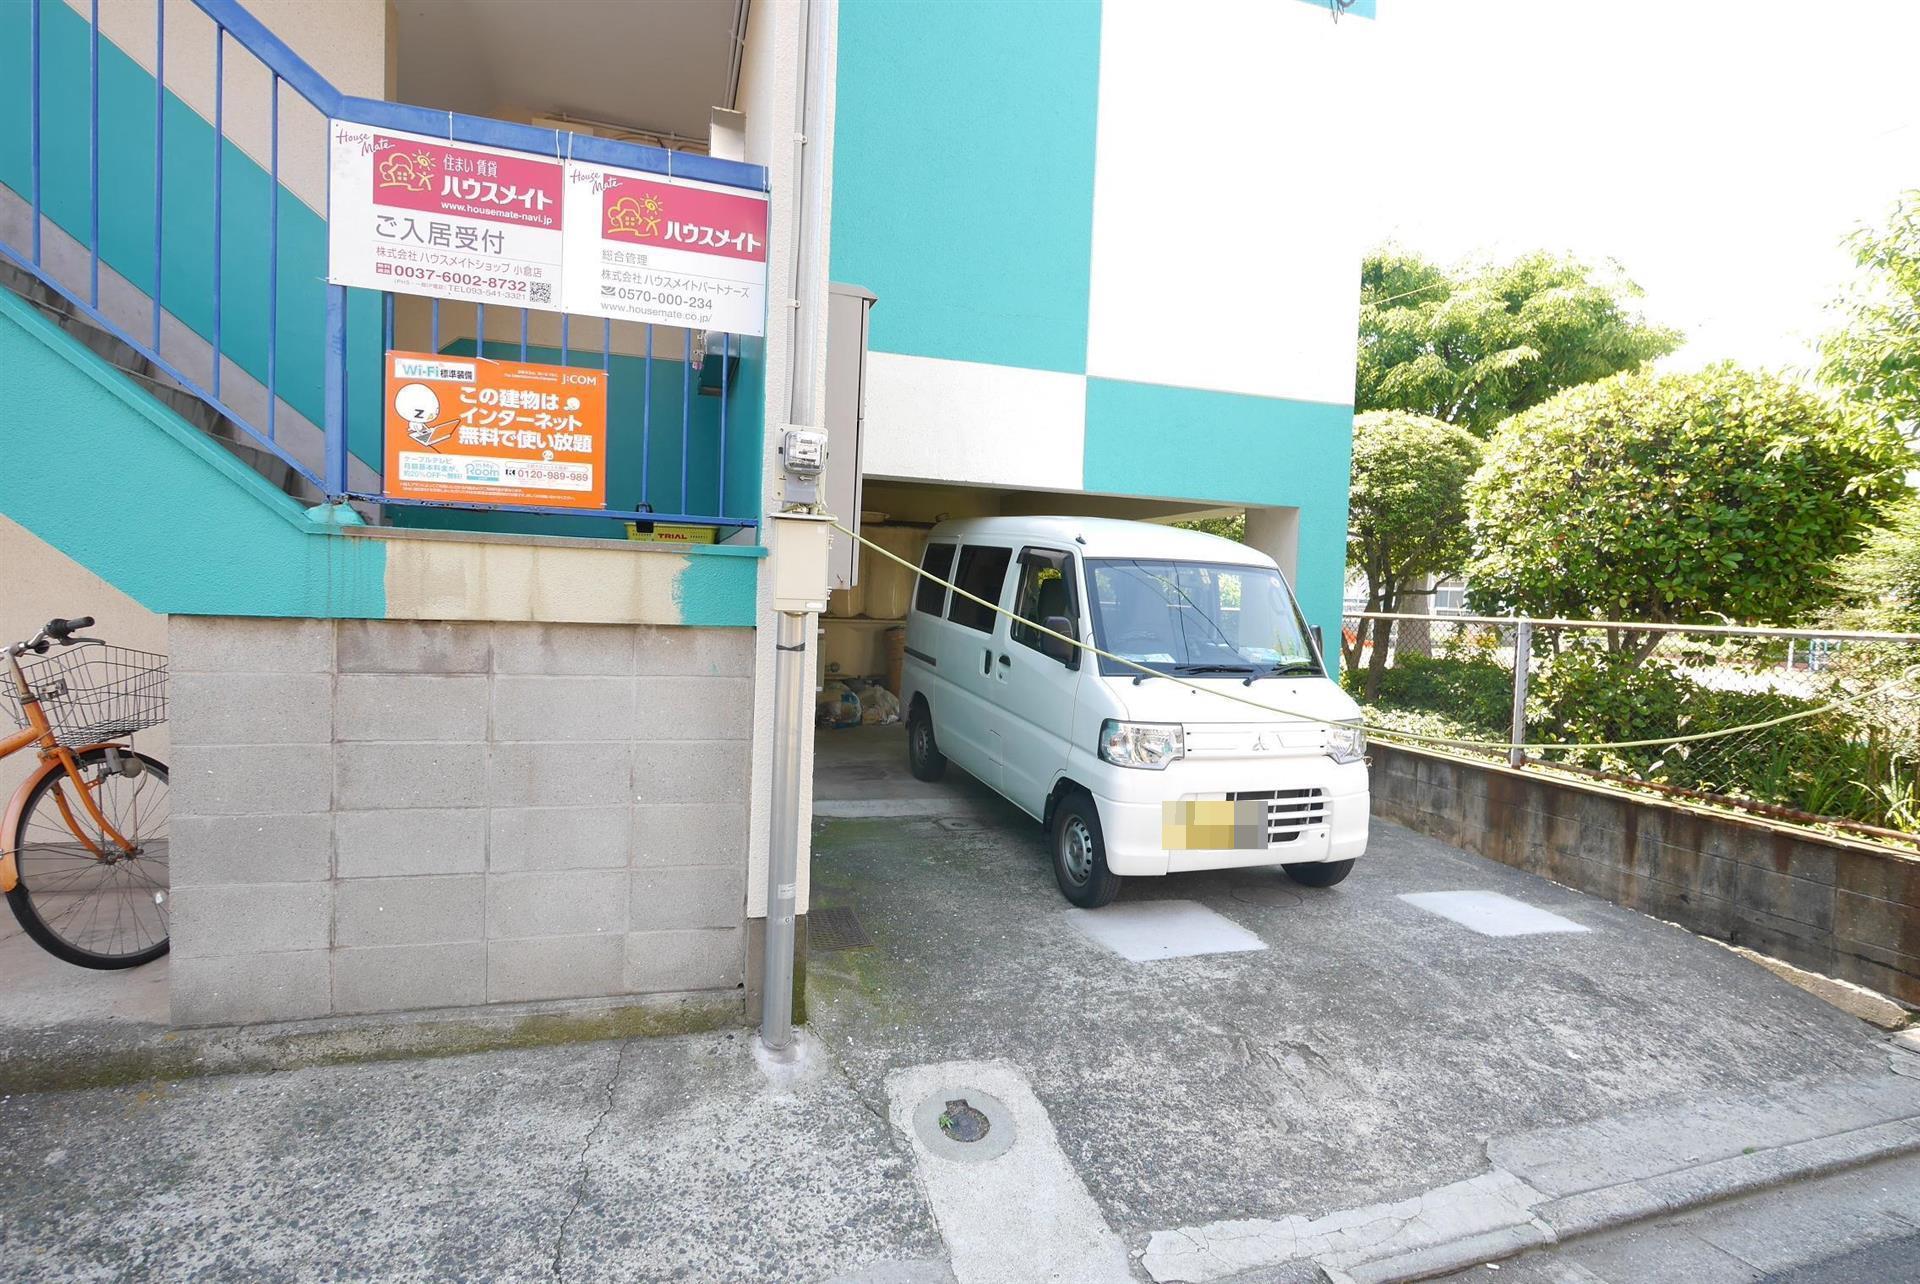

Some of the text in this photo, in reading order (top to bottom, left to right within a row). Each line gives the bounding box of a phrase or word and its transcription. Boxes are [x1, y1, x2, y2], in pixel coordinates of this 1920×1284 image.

[336, 128, 371, 144] House
[361, 139, 396, 156] Mate
[443, 154, 498, 178] 住まい 賃貸
[569, 169, 601, 185] House
[440, 175, 553, 211] ハウスメイト
[592, 178, 624, 195] Mate
[441, 201, 553, 225] www.housemate-navi.jp
[375, 214, 505, 255] ご入居受付
[664, 220, 762, 253] ハウスメイト
[375, 246, 418, 262] 株式会社
[420, 252, 510, 274] ハウスメイトショップ
[602, 249, 648, 266] 総合管理
[394, 265, 527, 293] 0037-6002-8732
[601, 269, 750, 298] 株式会社 ハウスメイトパートナーズ
[618, 287, 713, 310] 0570-000-234
[601, 301, 713, 323] www.housemate.co.jp/
[403, 363, 440, 378] Wi-Fi
[459, 386, 560, 411] この建物は
[459, 407, 583, 432] インターネット
[458, 426, 593, 454] 無料で使い放題
[517, 470, 589, 482] 0120-989-989
